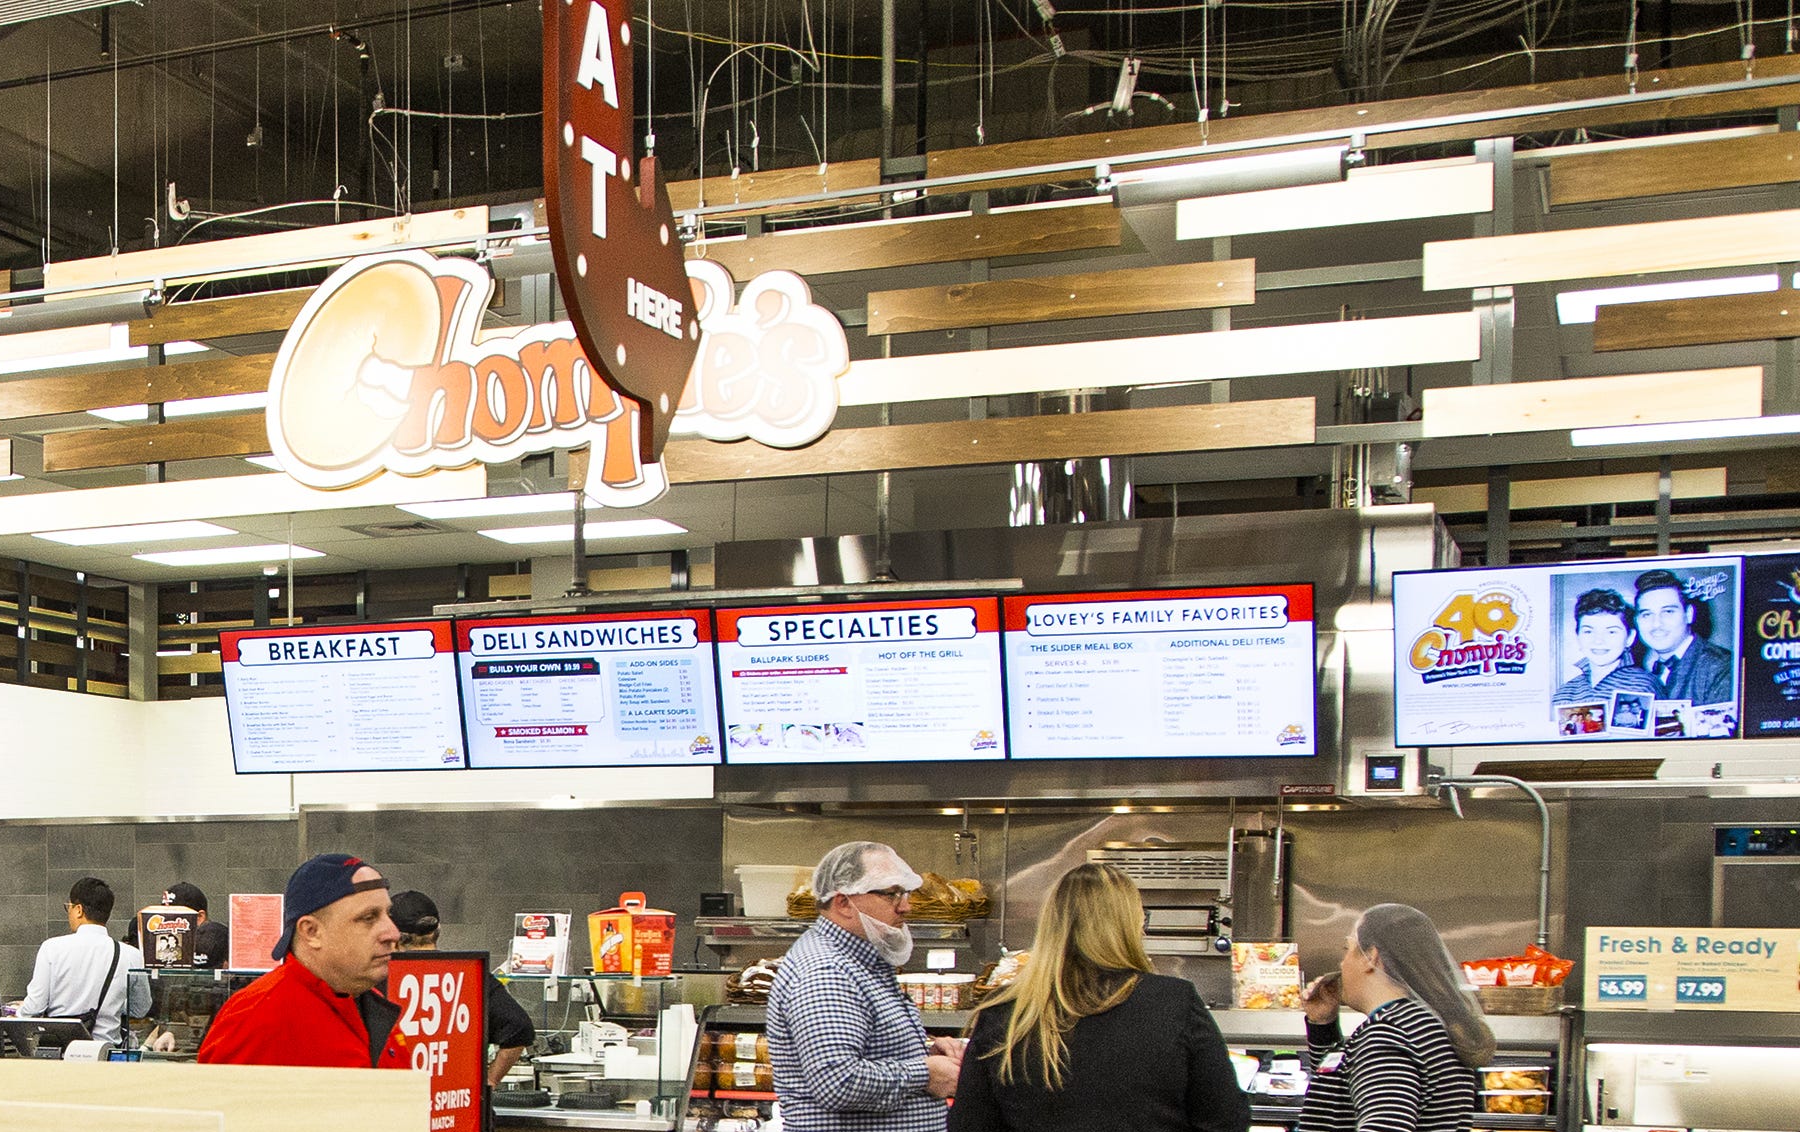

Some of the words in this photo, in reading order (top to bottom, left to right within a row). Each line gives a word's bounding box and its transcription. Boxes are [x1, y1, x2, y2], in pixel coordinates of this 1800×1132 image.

[626, 277, 683, 340] HERE
[1034, 612, 1105, 627] LOVEY'S
[1112, 609, 1175, 624] FAMILY
[1182, 605, 1279, 621] FAVORITES
[768, 614, 939, 642] SPECIALTIES
[483, 632, 527, 651] DELI
[535, 626, 683, 649] SANDWICHES
[1170, 639, 1230, 648] ADDITIONAL
[1232, 638, 1253, 647] DELI
[1256, 637, 1286, 646] ITEMS
[268, 637, 401, 662] BREAKFAST
[879, 652, 897, 660] HOT
[900, 651, 917, 660] OFF
[920, 651, 936, 659] THE
[939, 650, 964, 658] GRILL
[1030, 644, 1048, 652] THE
[1051, 643, 1082, 652] SLIDER
[1085, 643, 1110, 651] MEAL
[1113, 642, 1133, 650] BOX
[751, 655, 793, 664] BALLPARK
[796, 654, 830, 663] SLIDERS
[489, 665, 514, 674] BUILD
[514, 664, 539, 673] YOUR
[540, 663, 561, 672] OWN
[508, 728, 540, 736] SMOKED
[542, 727, 575, 735] SALMON
[1600, 935, 1662, 953] Fresh
[1671, 936, 1688, 953] &
[1696, 937, 1778, 959] Ready
[1260, 967, 1296, 975] DELICIOUS
[1601, 980, 1645, 996] $6.99
[1679, 981, 1724, 997] $7.99
[399, 971, 471, 1037] 25%
[411, 1040, 449, 1077] OFF
[435, 1088, 471, 1112] SPIRITS
[431, 1115, 455, 1131] MATCH
